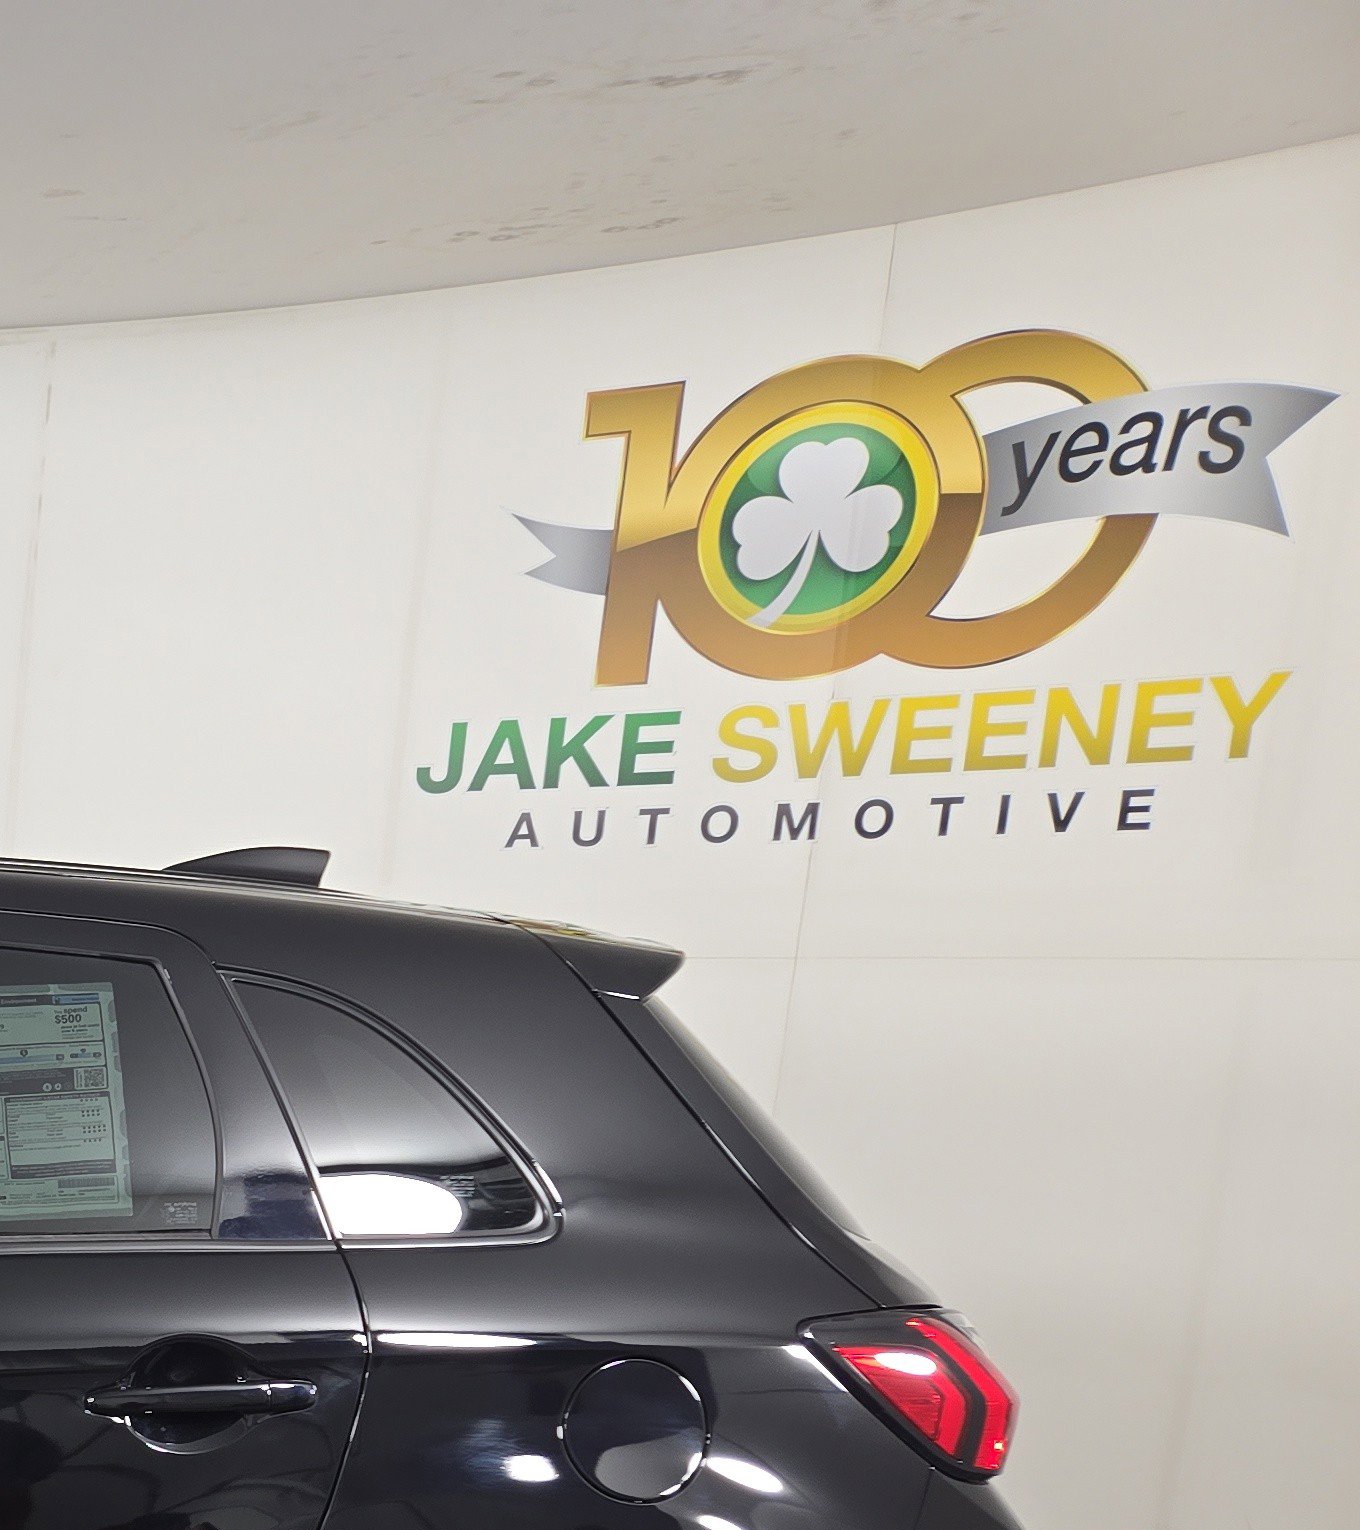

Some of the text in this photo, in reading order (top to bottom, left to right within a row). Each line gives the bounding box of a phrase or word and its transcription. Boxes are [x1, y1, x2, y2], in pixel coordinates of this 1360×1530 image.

[1000, 402, 1252, 518] years
[416, 671, 1294, 796] JAKE SWEENEY
[505, 788, 1156, 850] AUTOMOTIVE
[54, 1013, 82, 1024] $500
